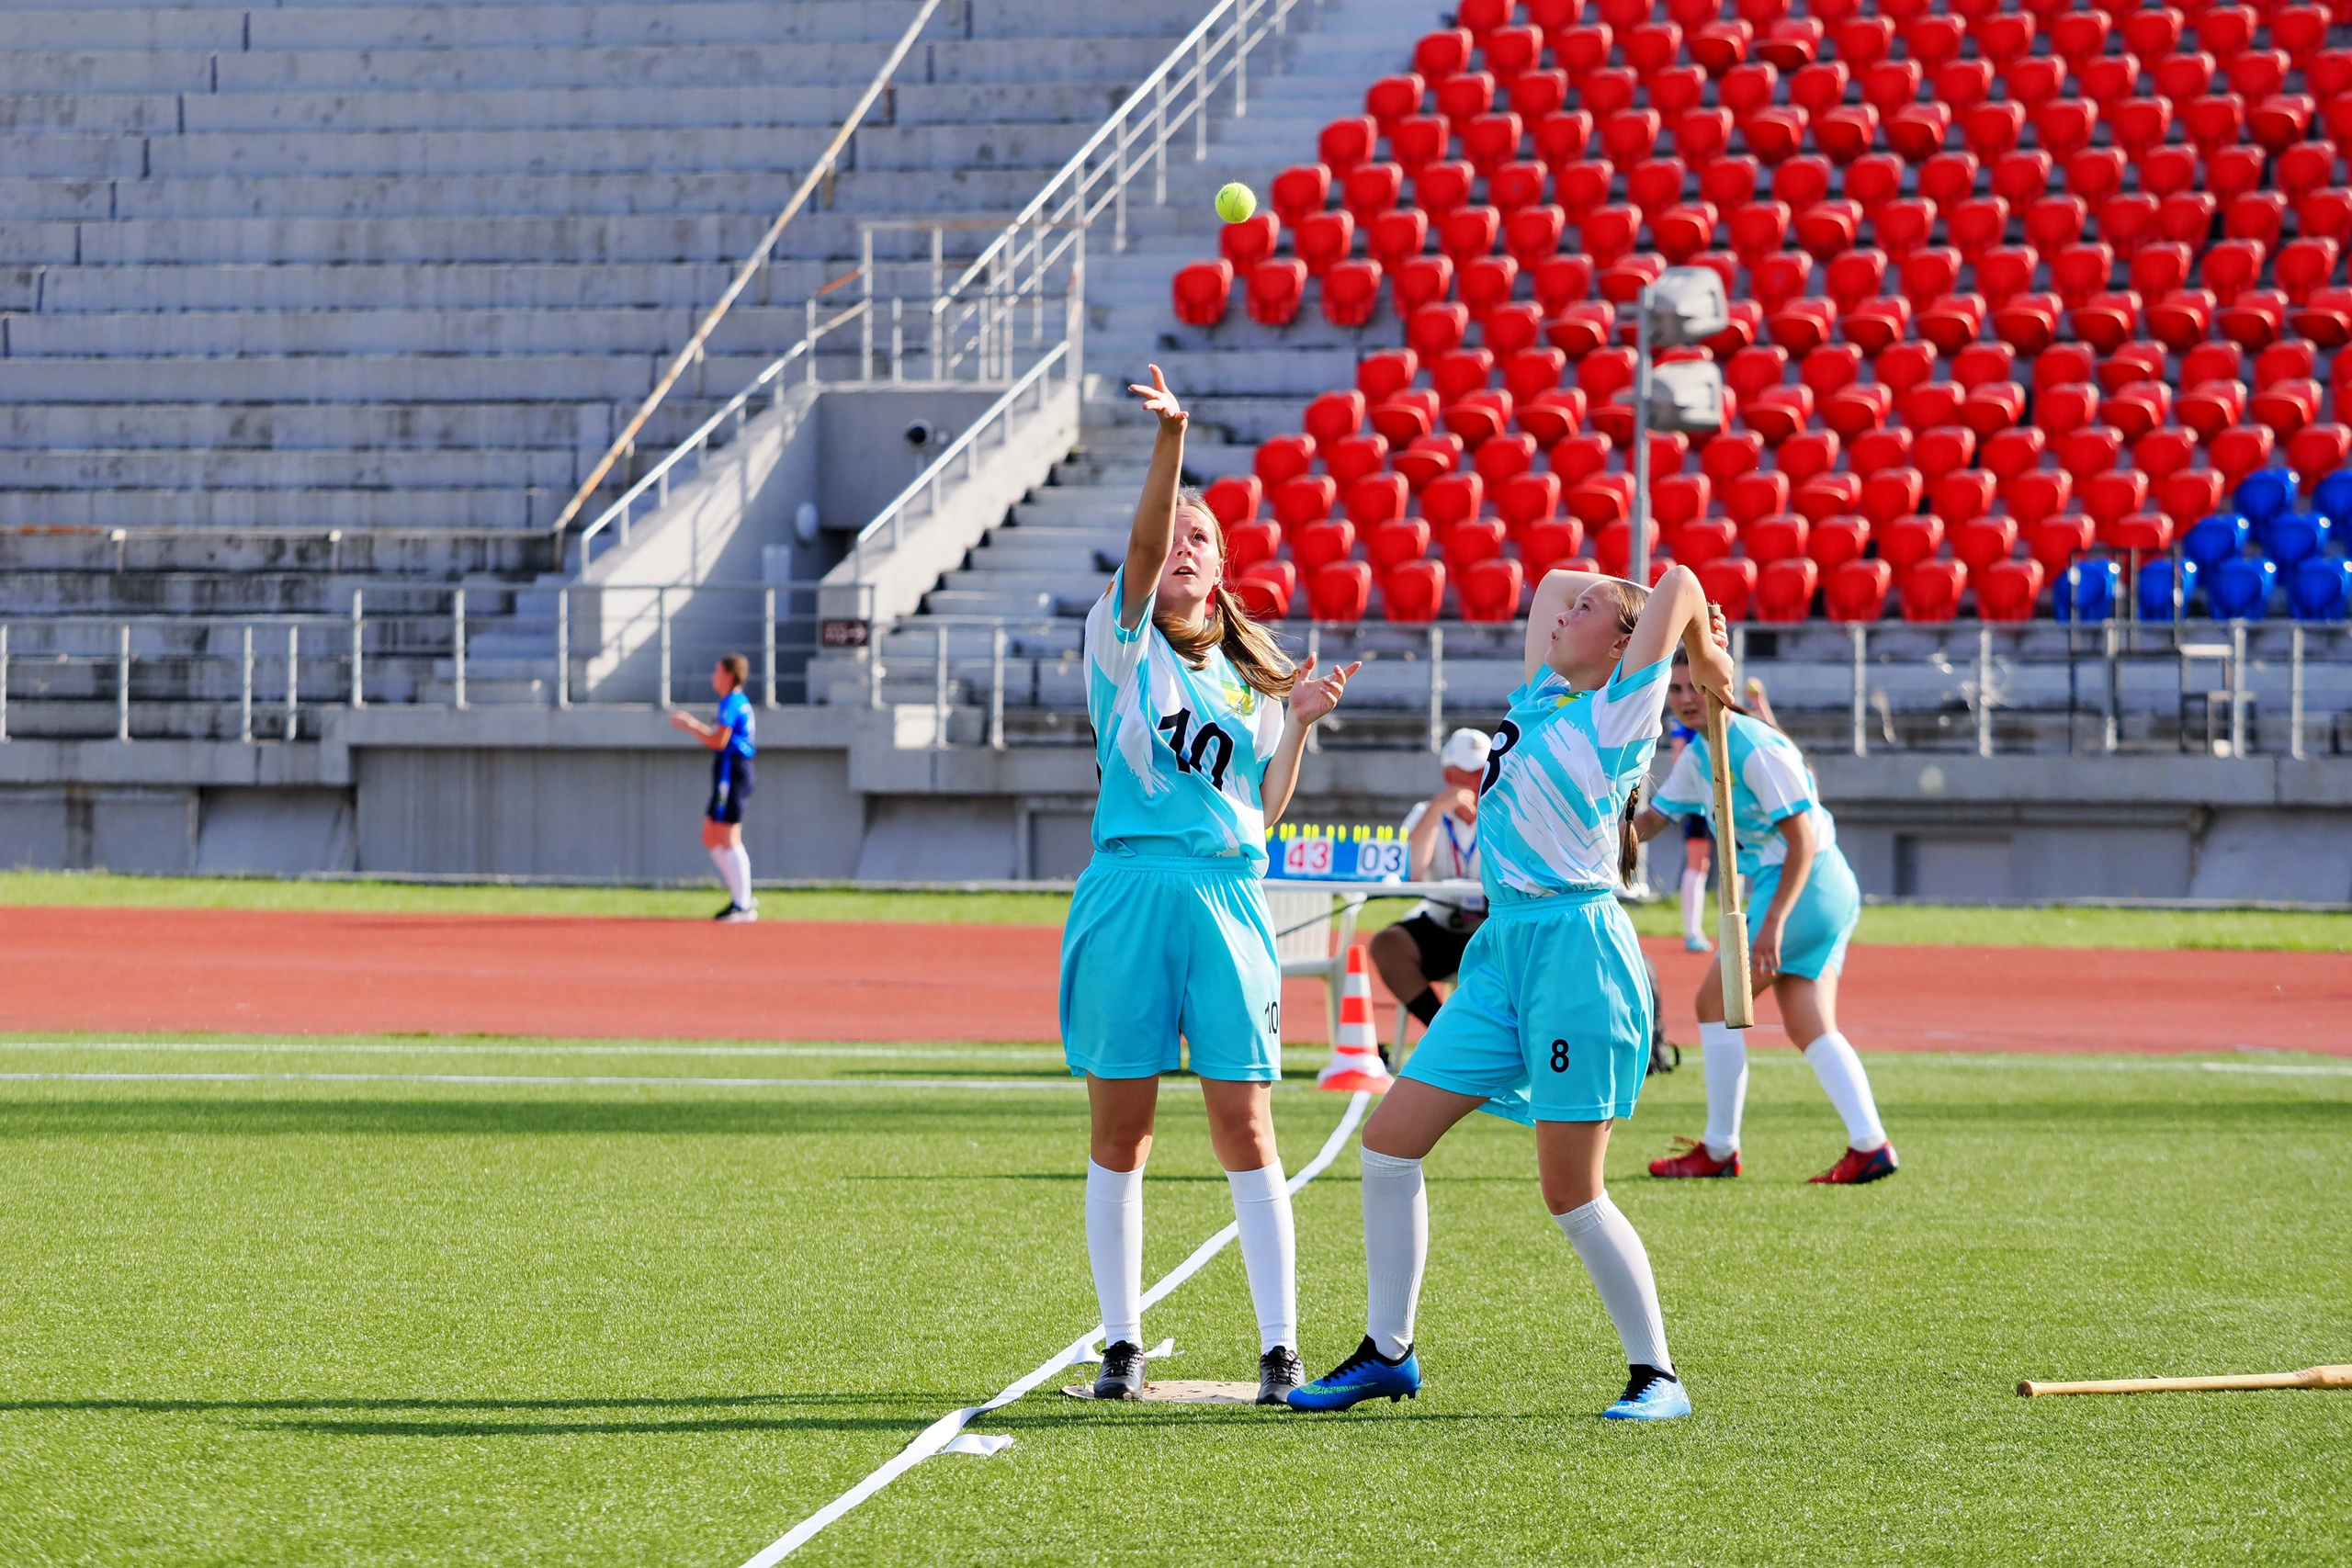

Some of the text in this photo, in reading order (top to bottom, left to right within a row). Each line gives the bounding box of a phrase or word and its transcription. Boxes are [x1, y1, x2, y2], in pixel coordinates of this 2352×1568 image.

[1158, 706, 1234, 792] 10
[1288, 840, 1402, 872] 43 03
[1264, 1001, 1279, 1034] 10
[1550, 1039, 1569, 1073] 8
